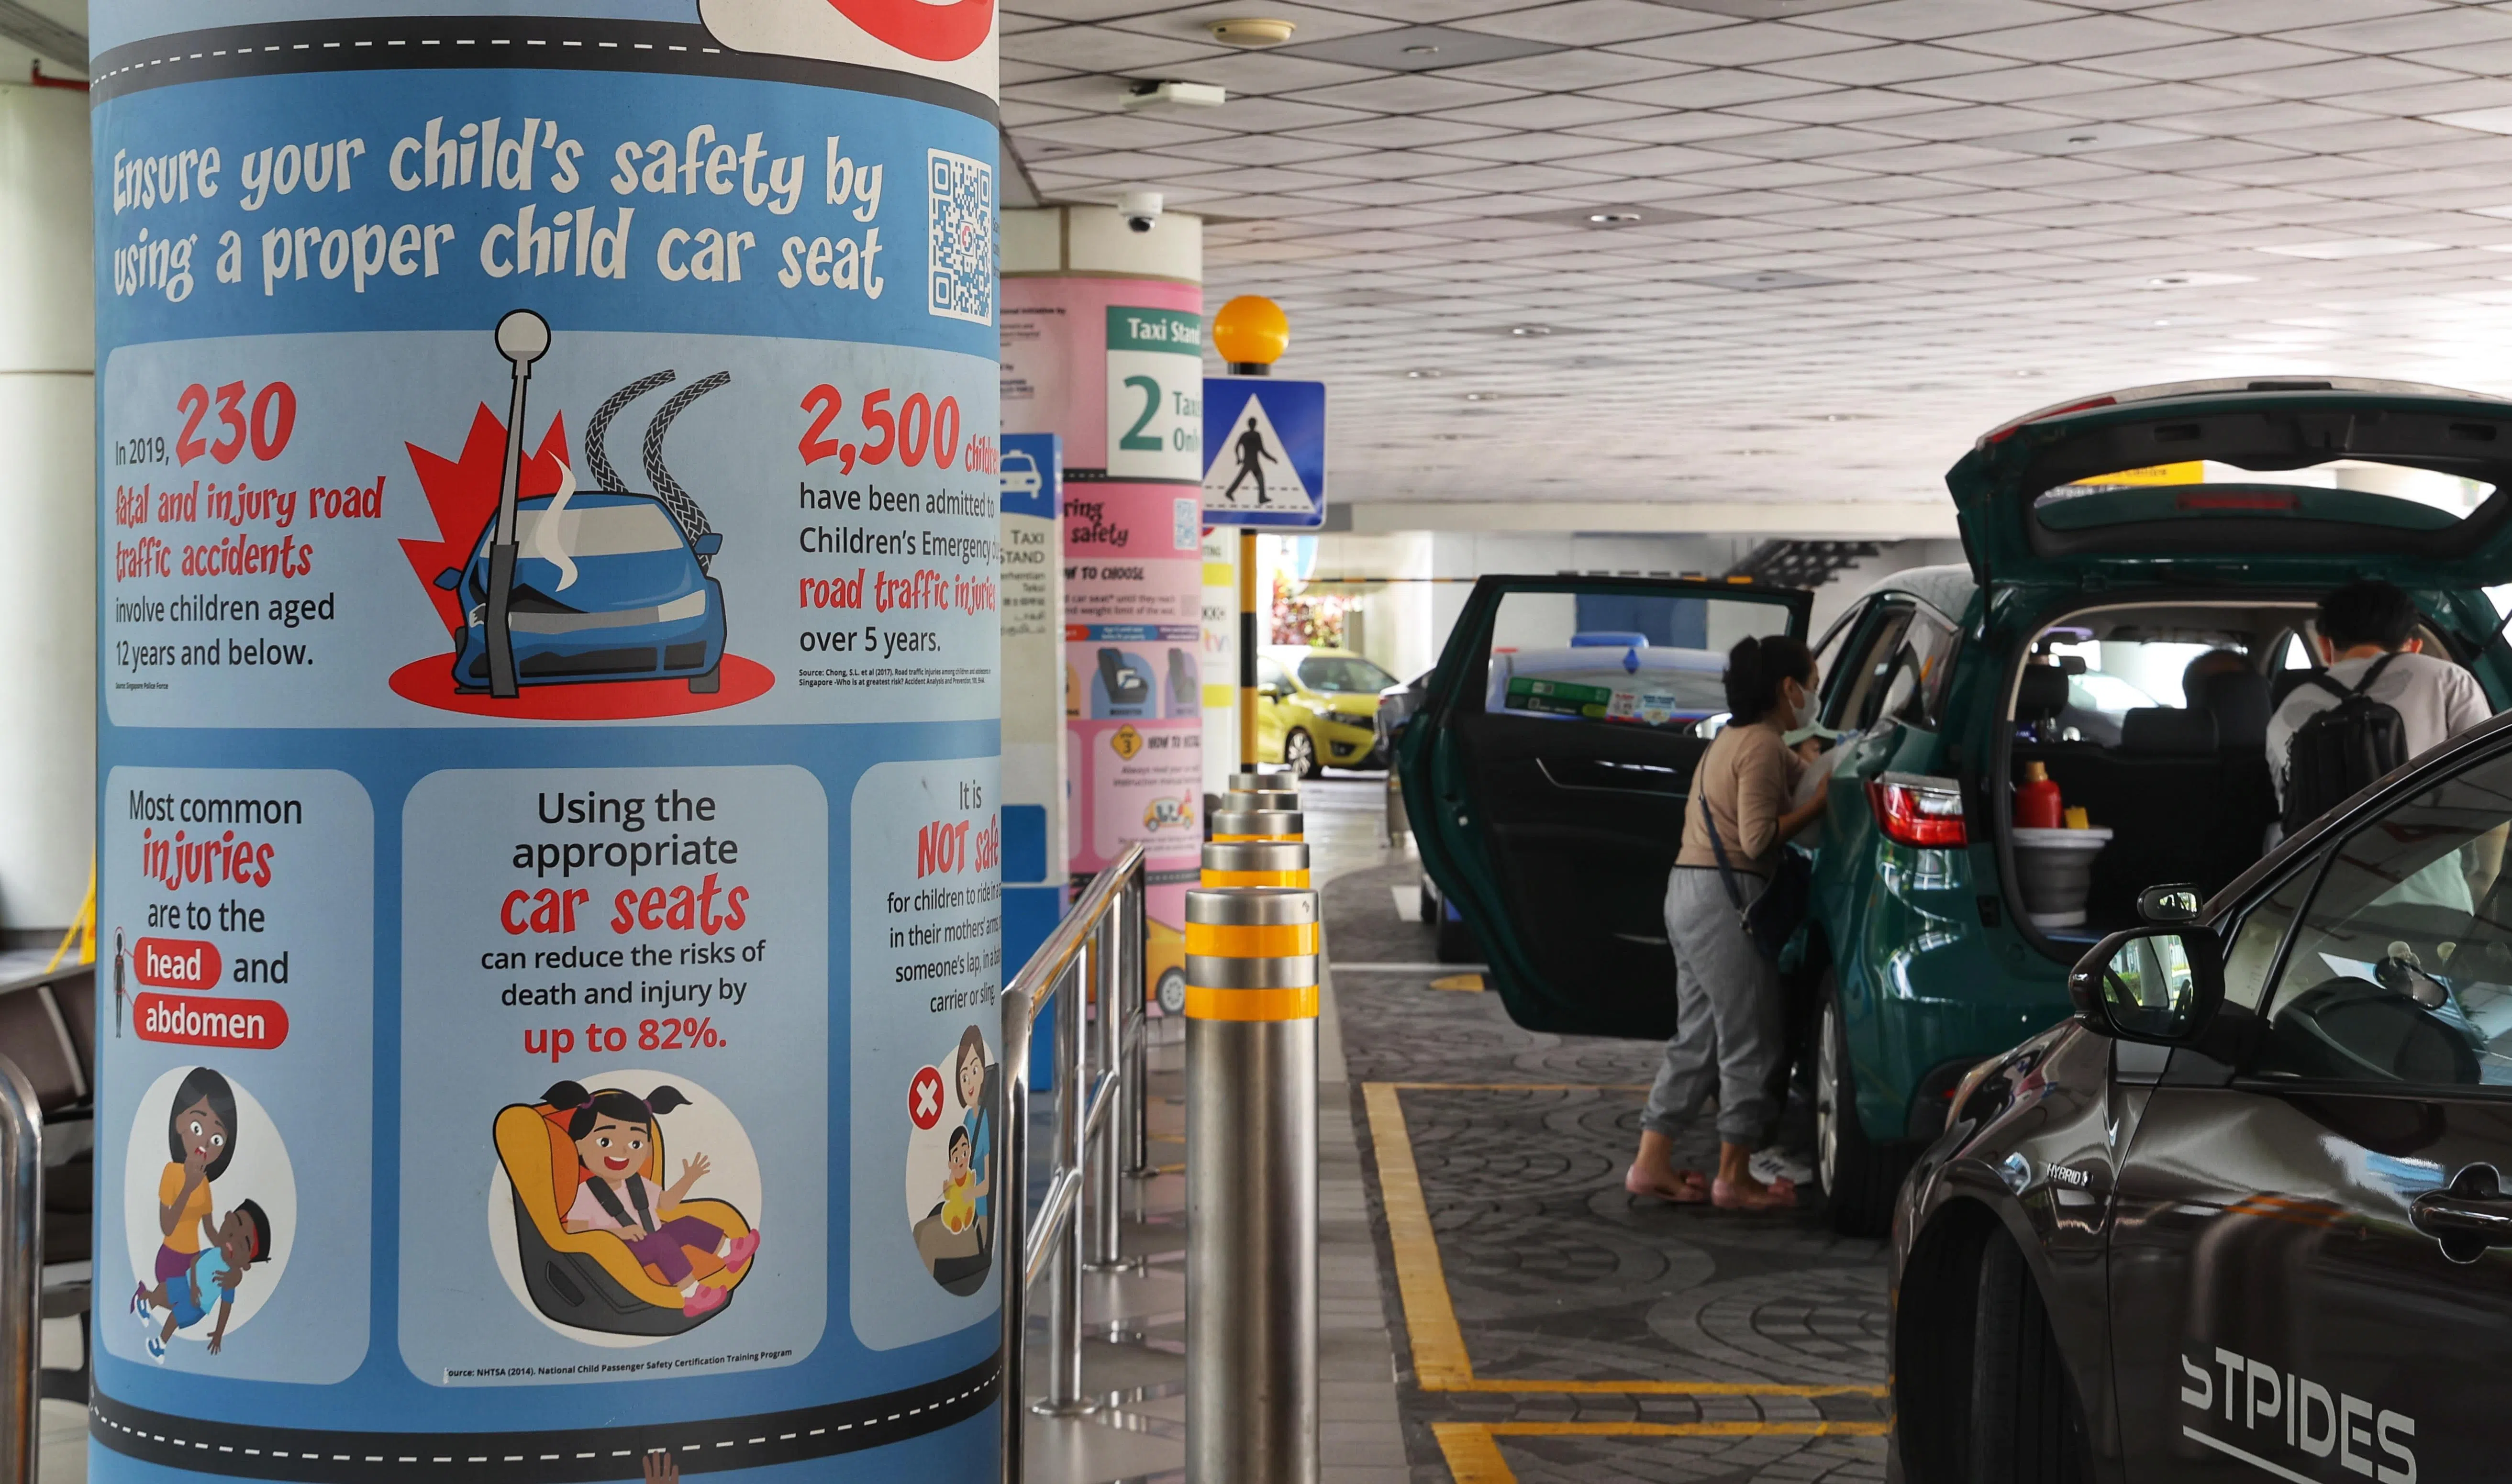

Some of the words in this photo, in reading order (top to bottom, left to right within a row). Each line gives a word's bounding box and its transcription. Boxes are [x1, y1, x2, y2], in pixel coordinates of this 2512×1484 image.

[113, 147, 221, 215] Ensure
[241, 136, 366, 210] your
[389, 116, 584, 192] child's
[611, 124, 805, 215] safety
[827, 135, 883, 222] by
[114, 228, 198, 302] using
[216, 230, 241, 284] a
[262, 223, 455, 296] proper
[480, 203, 635, 279] child
[656, 227, 756, 283] car
[778, 227, 884, 300] seat
[1127, 318, 1167, 341] Taxi
[1171, 321, 1201, 345] Stand
[176, 380, 297, 468] 230
[798, 384, 960, 476] 2,500
[1119, 375, 1163, 451] 2
[115, 441, 126, 465] In
[130, 436, 169, 466] 2019,
[115, 483, 150, 529] fatal
[157, 480, 200, 522] and
[207, 482, 297, 528] injury
[309, 476, 387, 520] road
[800, 482, 861, 510] have
[869, 484, 920, 513] been
[925, 488, 986, 517] admitted
[987, 498, 995, 519] to
[1065, 498, 1104, 521] ring
[800, 526, 916, 555] Children's
[922, 531, 991, 565] Emergency
[1071, 521, 1129, 547] safety
[115, 536, 171, 583] traffic
[181, 533, 314, 579] accidents
[116, 596, 165, 623] involve
[170, 594, 259, 622] children
[268, 592, 334, 628] aged
[800, 568, 866, 609] road
[874, 569, 949, 613] traffic
[955, 574, 996, 616] injuries
[116, 640, 129, 666] 12
[132, 642, 176, 674] years
[181, 638, 221, 666] and
[228, 638, 313, 666] below.
[800, 631, 857, 652] over
[865, 627, 878, 652] 5
[884, 631, 941, 659] years.
[799, 678, 833, 687] Singapore
[866, 678, 890, 687] greatest
[926, 677, 944, 686] Analysis
[825, 669, 848, 677] Chong,
[876, 669, 894, 677] (2017).
[924, 668, 941, 677] injuries
[130, 789, 174, 822] Most
[180, 798, 302, 824] common
[539, 791, 645, 832] Using
[655, 789, 716, 821] the
[960, 781, 969, 810] It
[973, 780, 982, 809] is
[144, 827, 275, 891] injuries
[512, 834, 738, 877] appropriate
[918, 820, 970, 879] NOT
[975, 813, 999, 873] safe
[148, 903, 180, 929] are
[187, 901, 211, 930] to
[218, 899, 265, 932] the
[500, 888, 589, 935] car
[610, 872, 749, 935] seats
[888, 892, 911, 913] for
[914, 887, 964, 911] children
[966, 887, 976, 906] to
[977, 882, 990, 903] ride
[890, 928, 904, 948] in
[909, 924, 941, 947] their
[945, 916, 985, 942] mothers'
[986, 917, 999, 935] arms
[147, 945, 201, 981] head
[233, 951, 289, 984] and
[481, 951, 526, 969] can
[534, 945, 623, 969] reduce
[631, 944, 672, 966] the
[680, 942, 735, 965] risks
[742, 940, 766, 962] of
[896, 955, 964, 983] someone's
[967, 952, 982, 977] lap,
[983, 949, 989, 969] in
[501, 984, 576, 1006] death
[584, 981, 632, 1004] and
[641, 980, 712, 1008] injury
[719, 978, 747, 1005] by
[931, 988, 967, 1013] carrier
[970, 990, 978, 1006] or
[146, 1001, 265, 1040] abdomen
[524, 1026, 575, 1063] up
[586, 1023, 627, 1052] to
[638, 1017, 727, 1050] 82%.
[2047, 1163, 2081, 1185] HYBRID
[446, 1367, 475, 1377] ource:
[508, 1367, 536, 1377] (2014).
[538, 1366, 575, 1375] National
[578, 1364, 599, 1373] Child
[602, 1362, 645, 1373] Passenger
[646, 1360, 673, 1371] Safety
[675, 1356, 725, 1368] Certification
[727, 1352, 759, 1363] Training
[761, 1349, 792, 1360] Program
